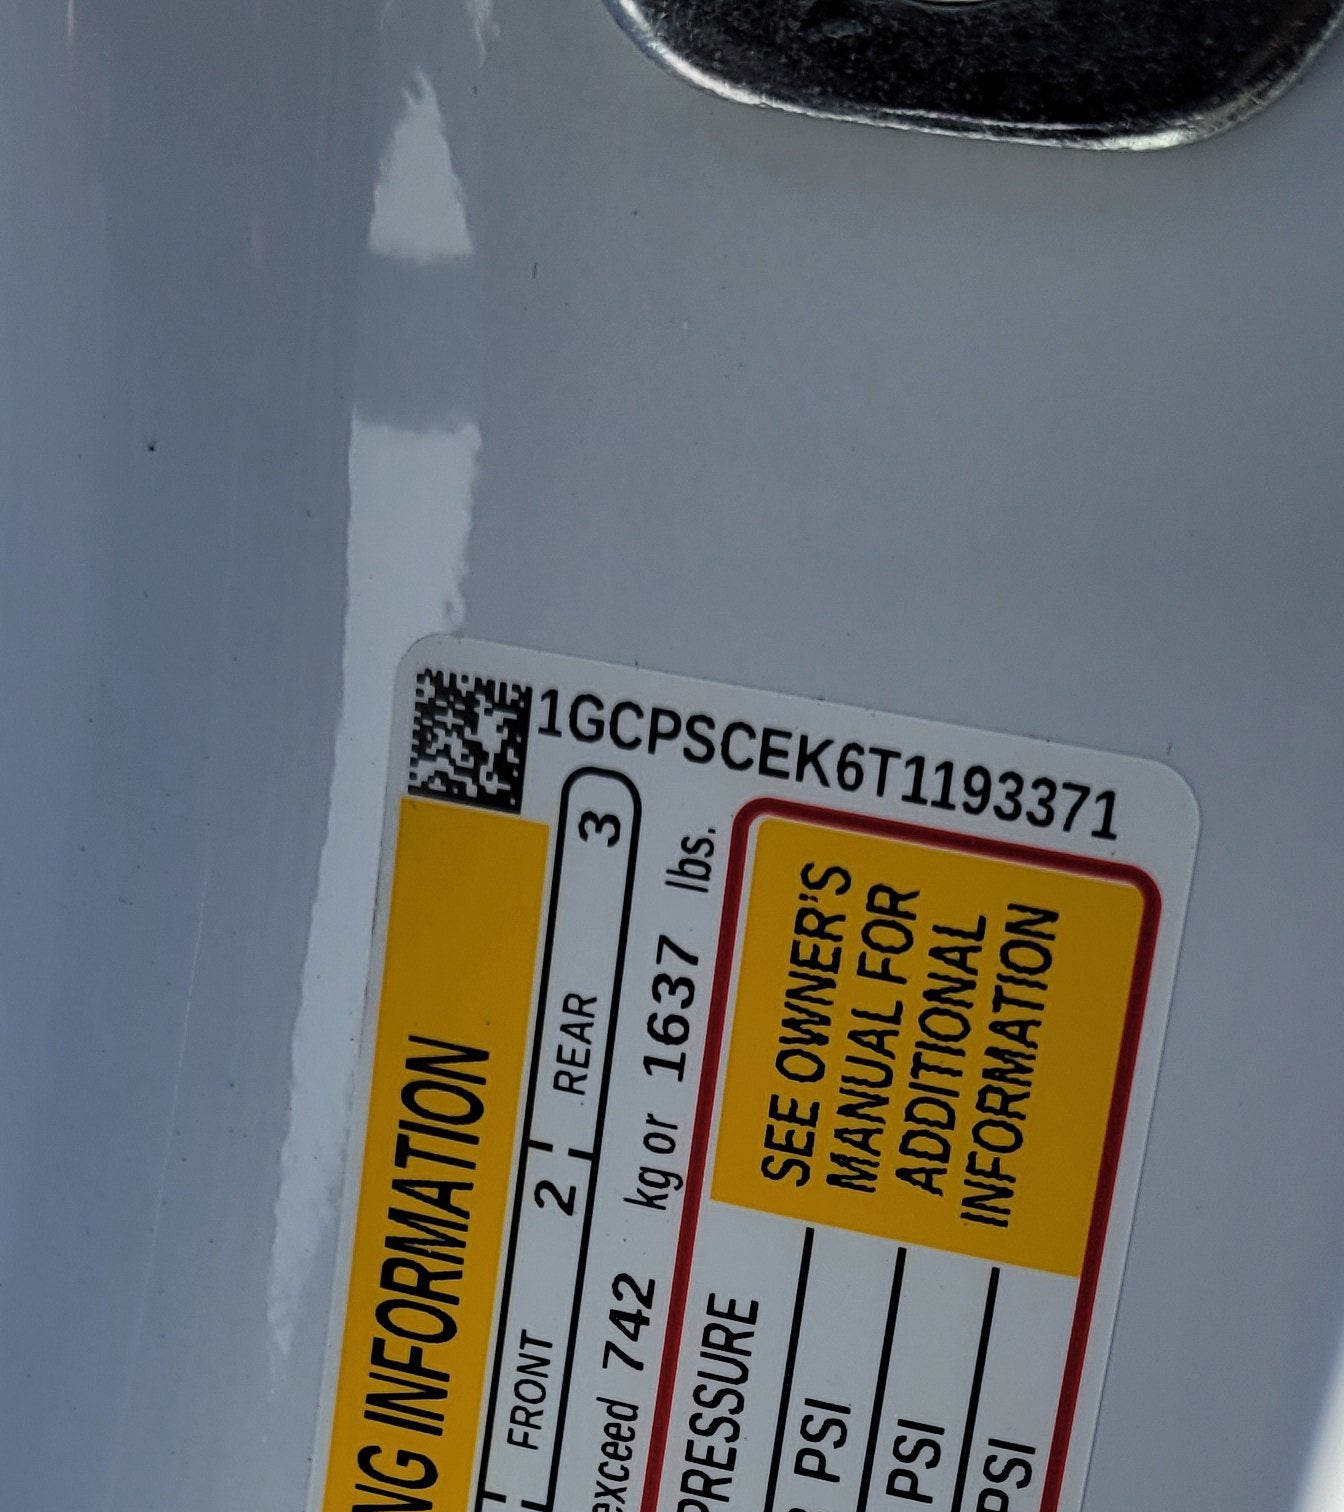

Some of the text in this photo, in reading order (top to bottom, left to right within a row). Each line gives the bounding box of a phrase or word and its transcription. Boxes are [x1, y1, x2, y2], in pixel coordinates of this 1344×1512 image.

[538, 688, 1117, 841] 1GCPSCEK6T1193371
[664, 826, 715, 893] lbs.
[552, 810, 621, 1096] REAR 3
[642, 934, 699, 1082] 1637
[760, 862, 852, 1188] SEE OWNER'S
[826, 883, 920, 1193] MANUAL FOR
[895, 914, 987, 1197] ADDITIONAL
[960, 903, 1060, 1228] INFORMATION
[623, 1166, 684, 1211] kg
[642, 1112, 679, 1155] or
[363, 1034, 490, 1437] INFORMATION
[506, 1179, 577, 1451] FRONT 2
[602, 1272, 656, 1372] 742
[793, 1397, 852, 1483] PSI
[885, 1418, 945, 1504] PSI
